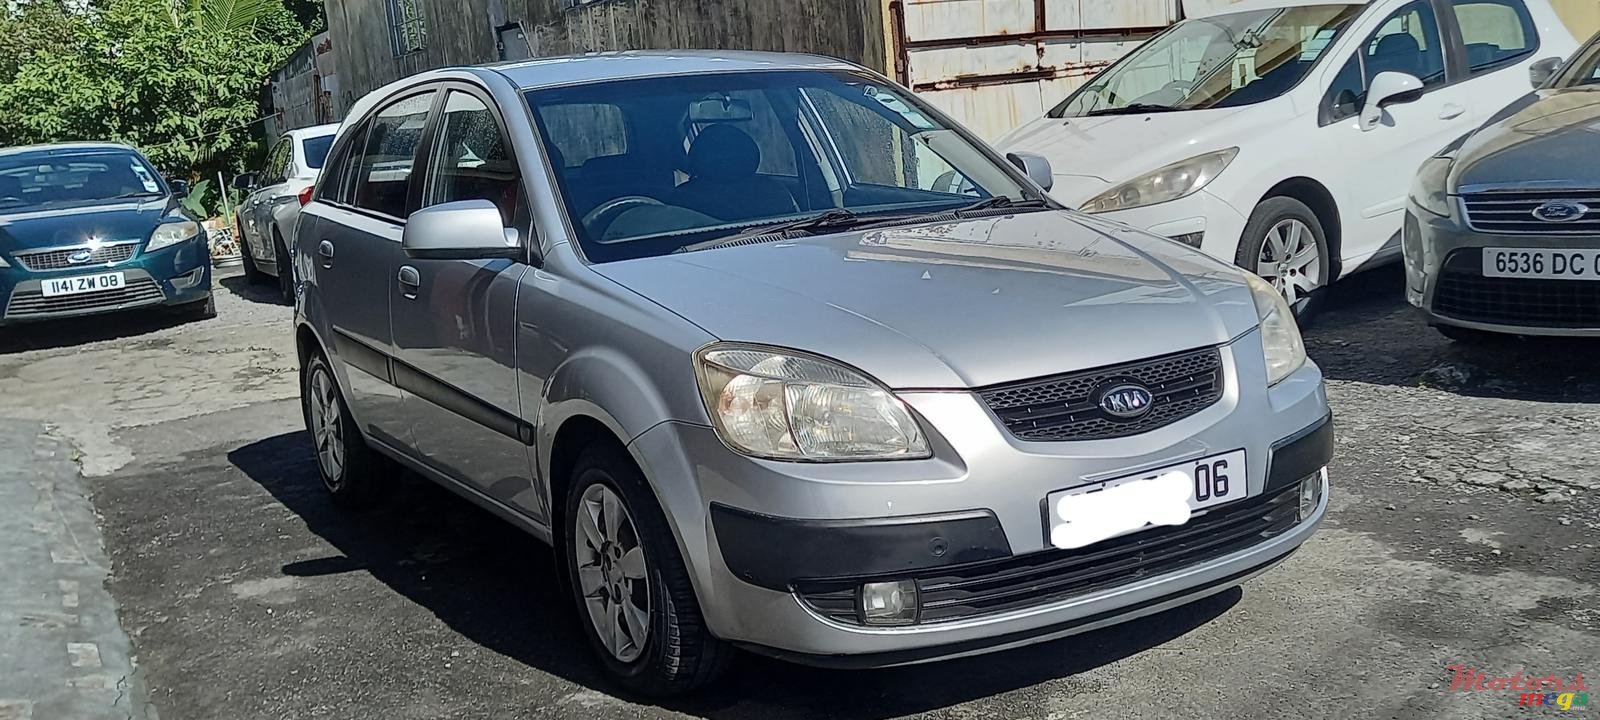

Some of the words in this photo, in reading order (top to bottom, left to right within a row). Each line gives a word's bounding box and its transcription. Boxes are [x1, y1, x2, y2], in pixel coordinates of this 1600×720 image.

[1495, 251, 1544, 274] 6536
[1552, 253, 1585, 275] DC
[51, 281, 74, 293] 1141
[77, 277, 96, 291] ZW
[100, 275, 118, 288] 08
[1108, 390, 1147, 412] KIA
[1194, 459, 1229, 502] 06
